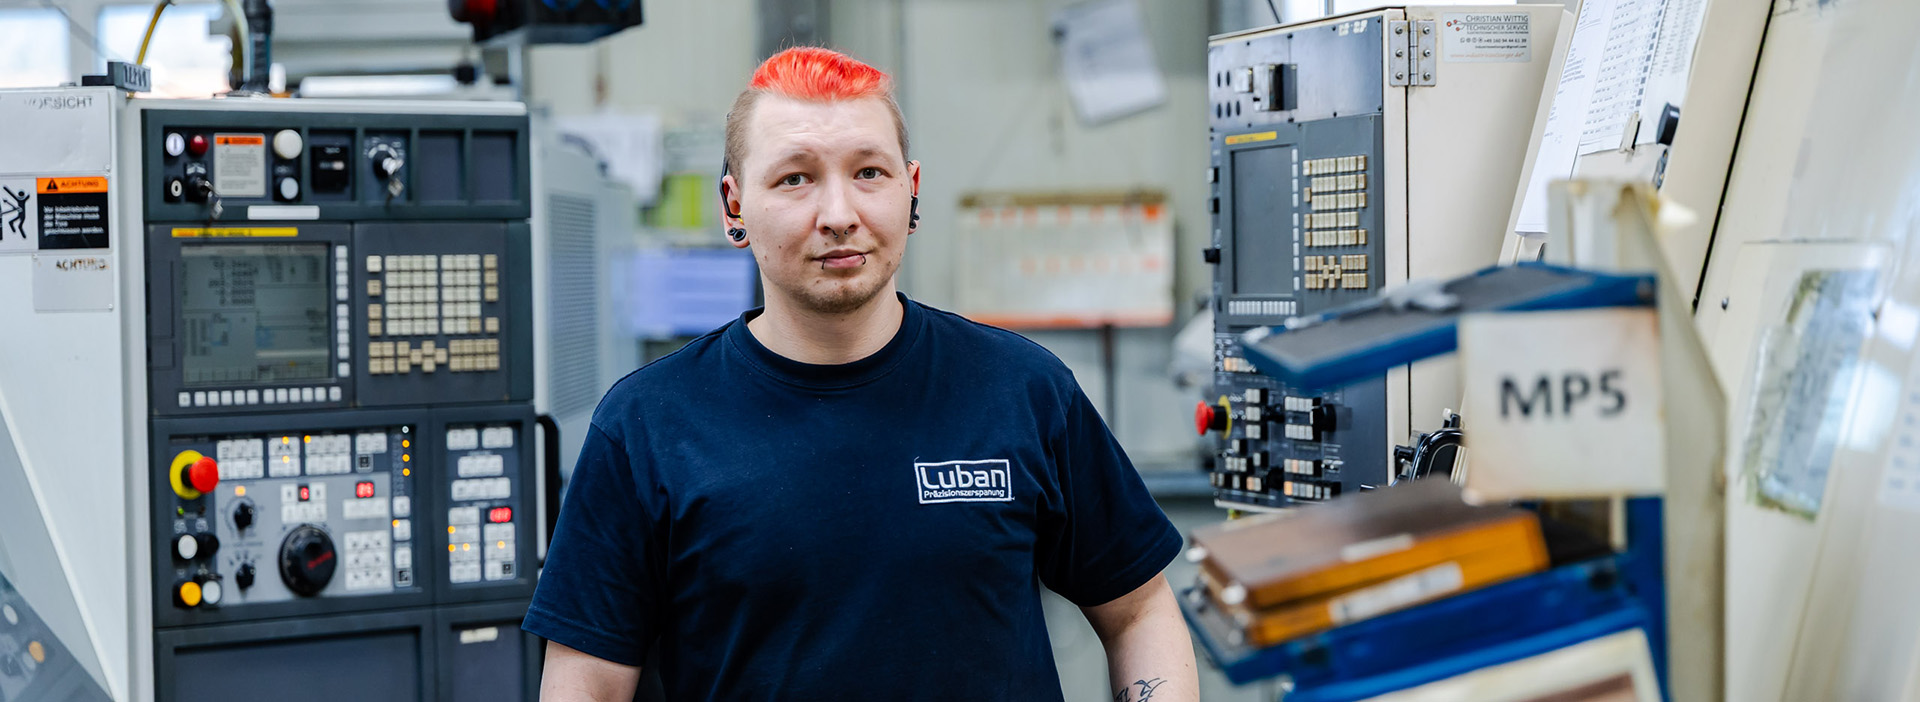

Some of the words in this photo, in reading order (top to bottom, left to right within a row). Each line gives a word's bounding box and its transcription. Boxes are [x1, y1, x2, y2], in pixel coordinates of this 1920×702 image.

[1465, 14, 1502, 22] CHRISTIAN
[1503, 14, 1529, 22] WITTIG
[61, 180, 99, 188] ACHTUNG
[1499, 369, 1626, 419] MP5
[920, 464, 1006, 489] Luban
[924, 489, 1005, 499] Präzisionszerspanung
